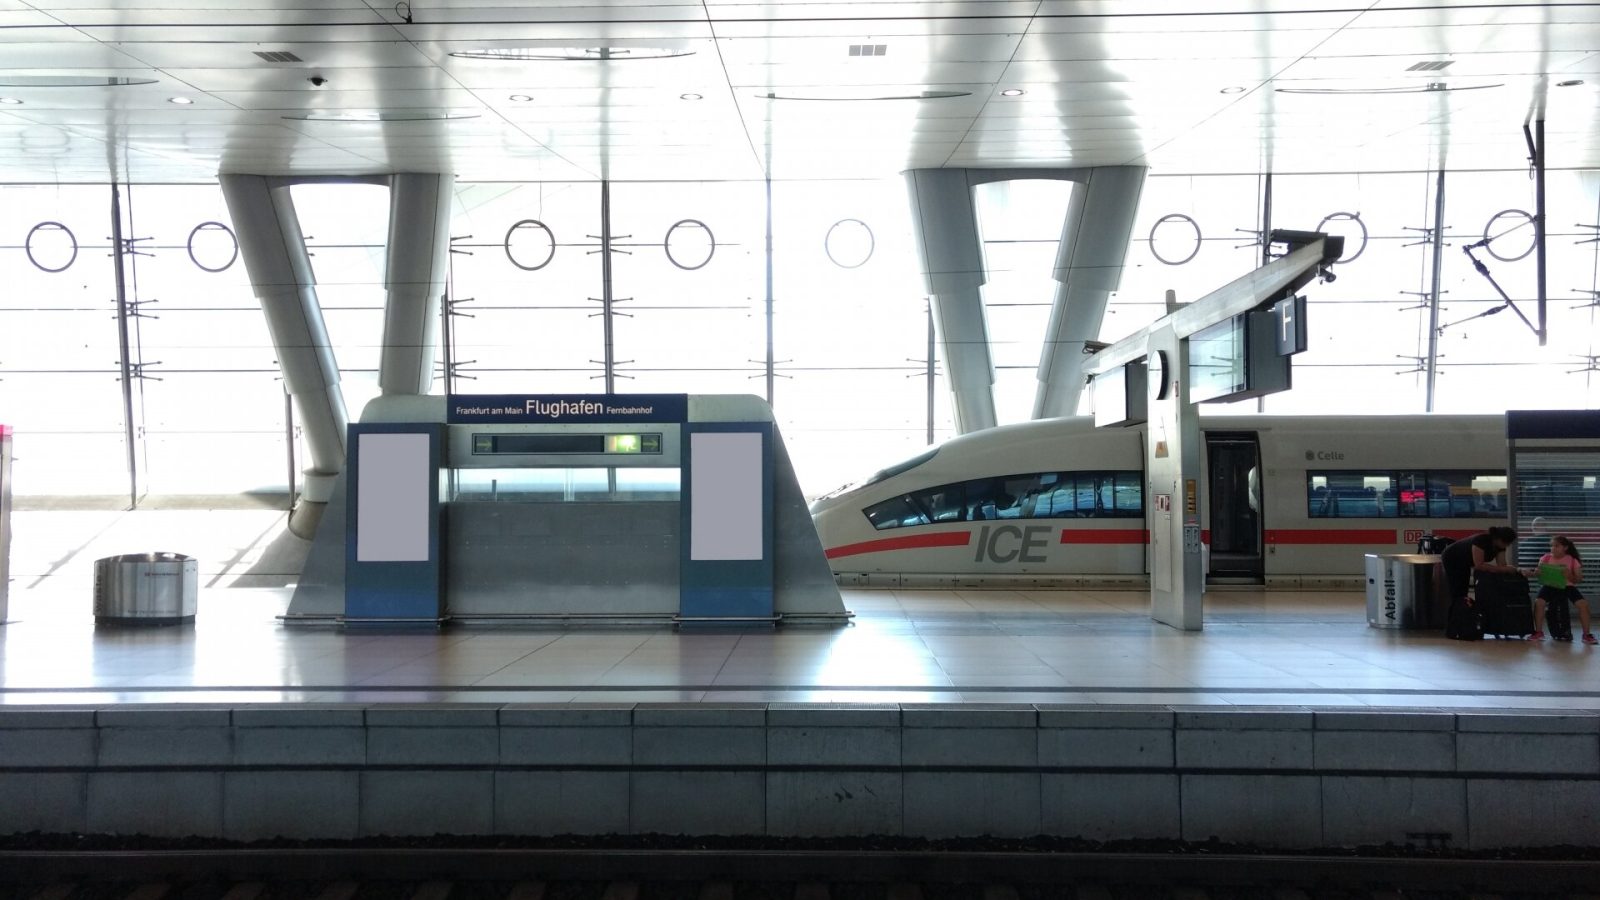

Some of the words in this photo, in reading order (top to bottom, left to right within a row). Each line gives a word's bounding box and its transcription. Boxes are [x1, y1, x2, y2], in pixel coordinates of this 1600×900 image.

[1283, 301, 1291, 341] F
[456, 406, 490, 415] Frankfurt
[491, 407, 503, 415] am
[504, 406, 523, 415] Main
[526, 399, 603, 417] Flughafen
[606, 406, 653, 415] Fernbahnhof
[1317, 450, 1345, 461] Celle
[974, 525, 1053, 563] ICE
[1384, 579, 1396, 620] Abfall
